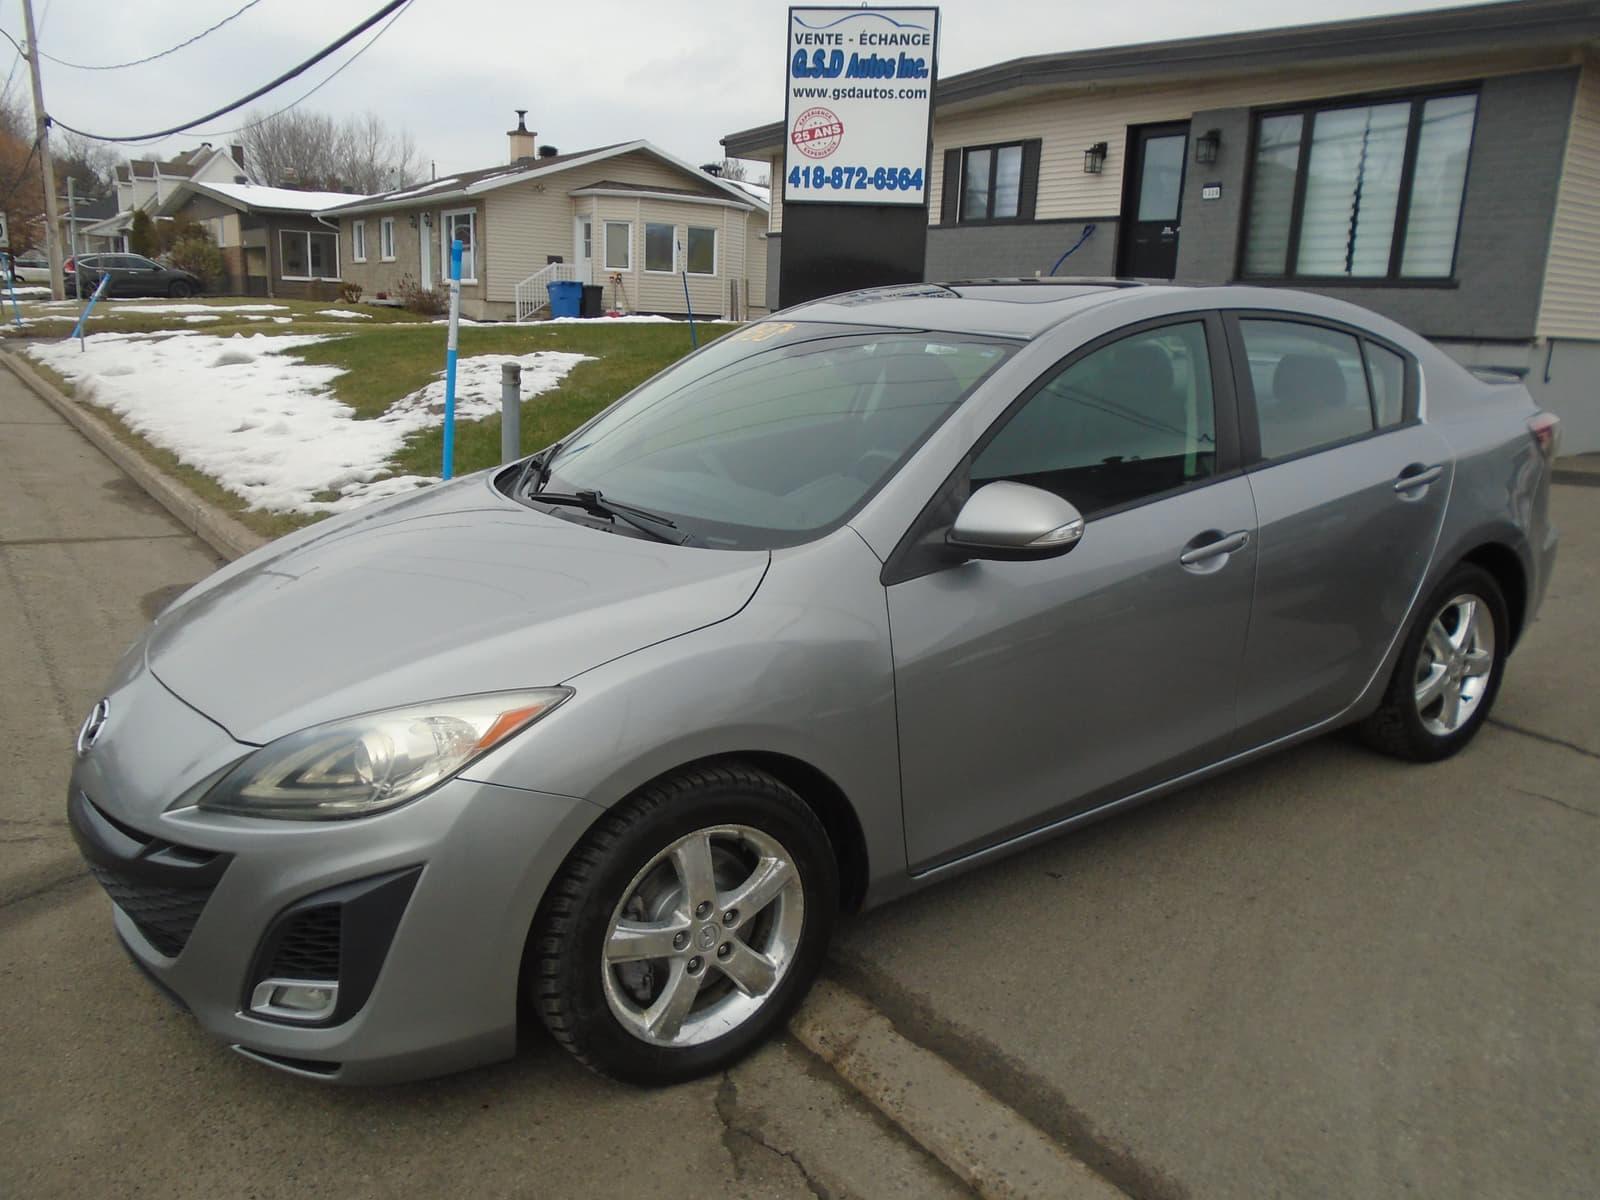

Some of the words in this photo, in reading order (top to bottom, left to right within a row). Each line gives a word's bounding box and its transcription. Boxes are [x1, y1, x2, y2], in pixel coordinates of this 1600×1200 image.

[794, 33, 843, 45] VENTE
[859, 30, 931, 46] ÉCHANGE
[845, 52, 896, 79] Autos
[896, 52, 929, 79] Inc.
[793, 87, 927, 100] www.gsdautos.com
[794, 130, 810, 143] 25
[814, 123, 841, 139] ANS
[788, 166, 923, 191] 418-872-6564
